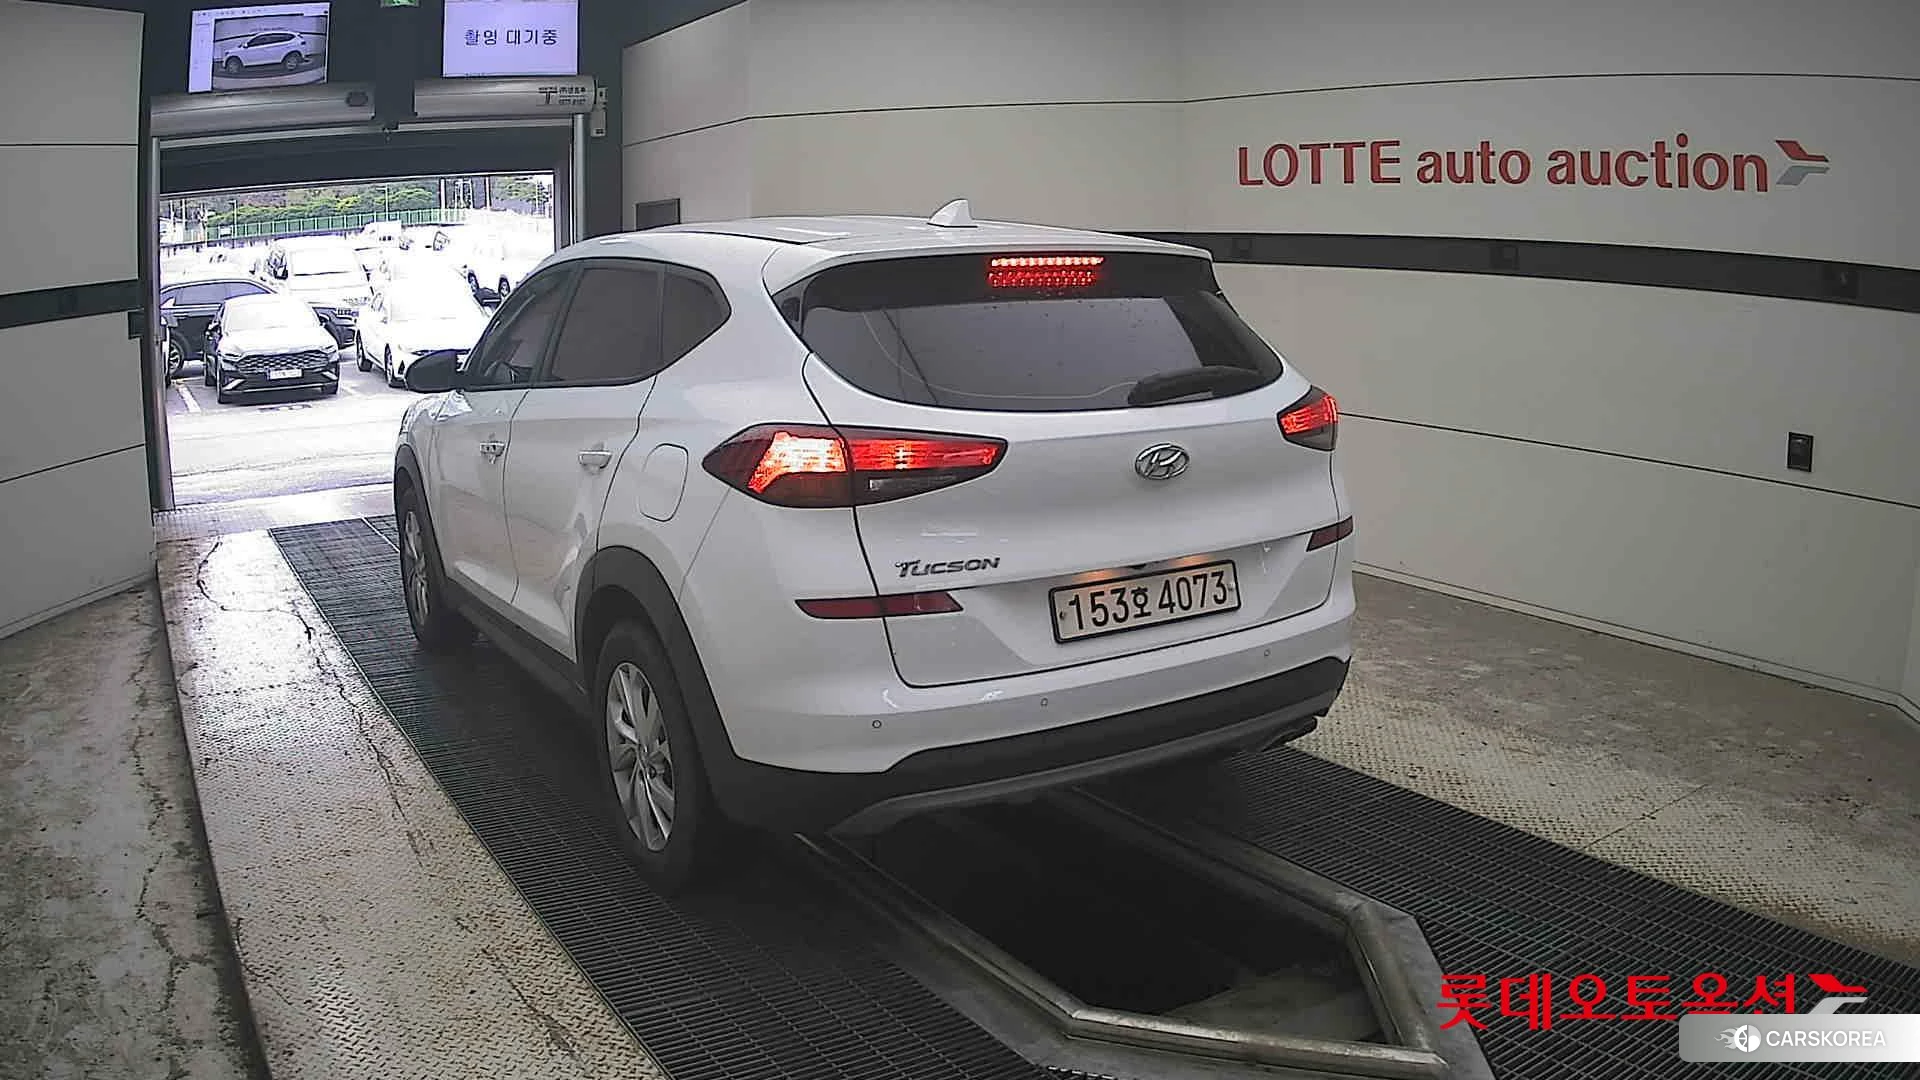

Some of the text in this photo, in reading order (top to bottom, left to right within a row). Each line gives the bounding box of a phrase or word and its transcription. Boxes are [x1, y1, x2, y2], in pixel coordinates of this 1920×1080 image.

[505, 28, 560, 46] 대기중
[1238, 133, 1769, 192] LOTTE auto auction
[1158, 571, 1228, 614] 4073
